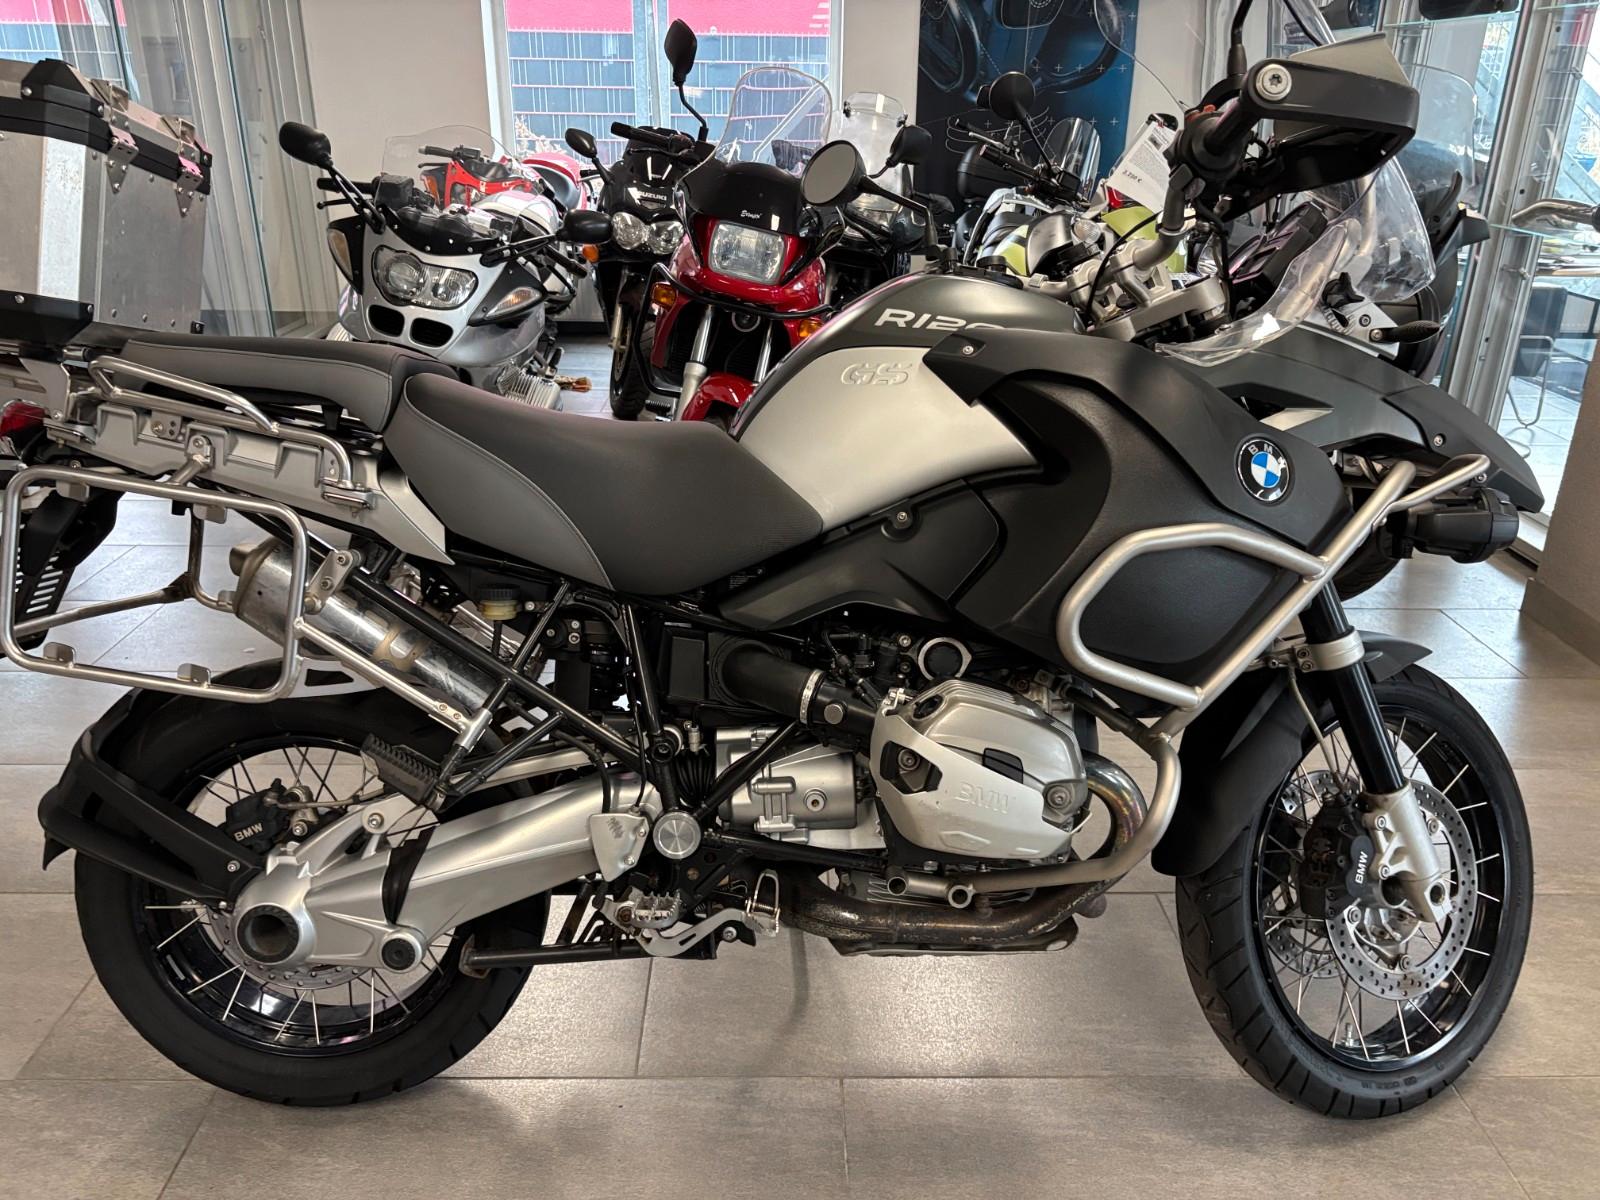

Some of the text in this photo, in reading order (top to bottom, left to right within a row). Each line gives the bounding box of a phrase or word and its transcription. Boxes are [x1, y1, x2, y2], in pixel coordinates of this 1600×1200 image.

[874, 308, 1005, 331] R12
[841, 362, 912, 385] GS
[953, 781, 1010, 815] BMW
[233, 822, 263, 842] BMW
[1354, 850, 1368, 885] BMW
